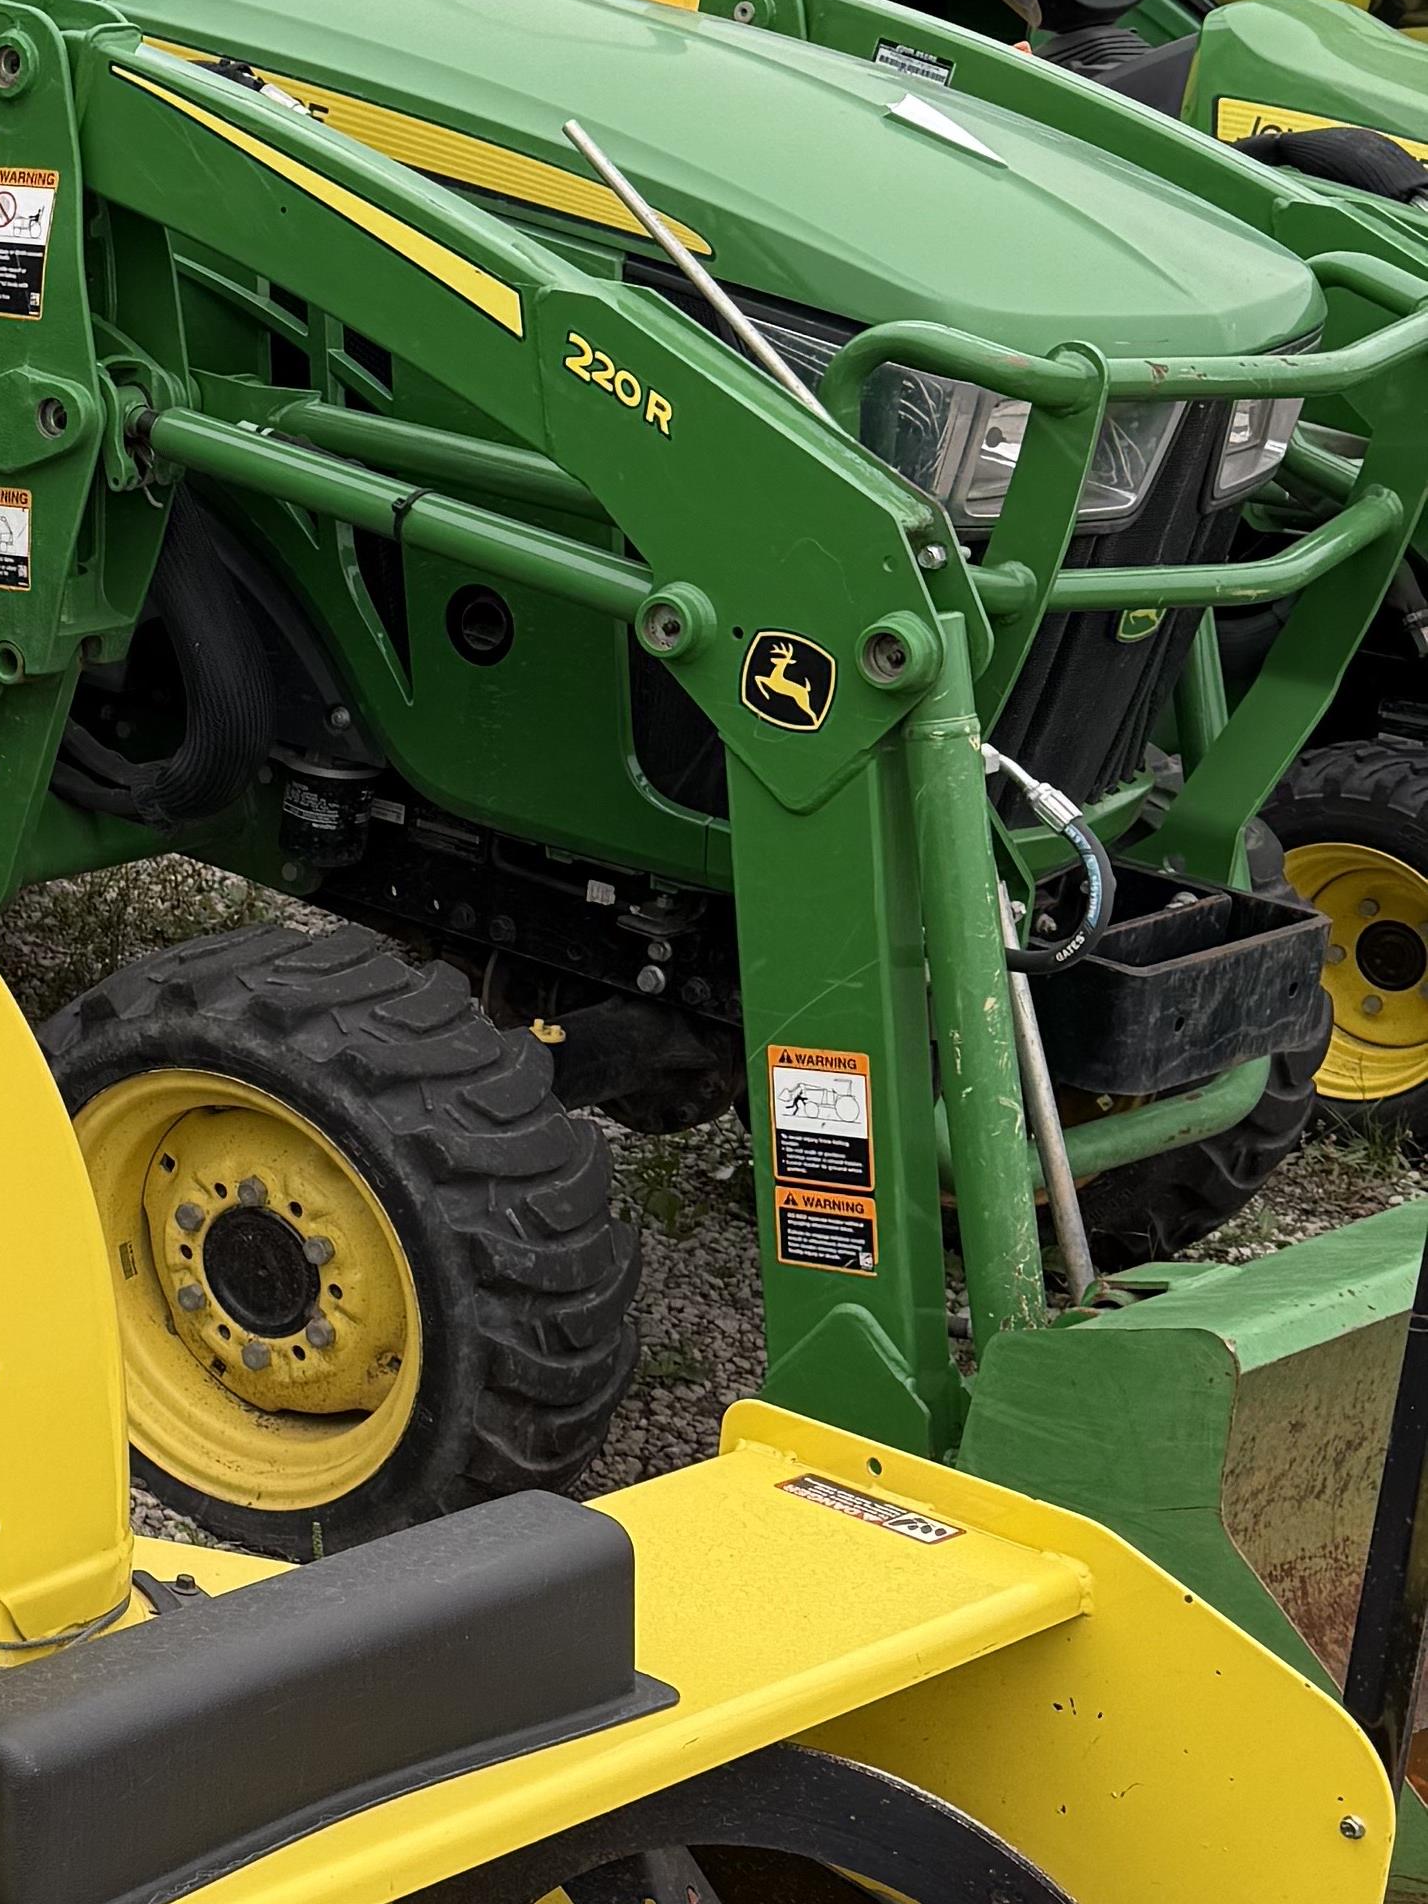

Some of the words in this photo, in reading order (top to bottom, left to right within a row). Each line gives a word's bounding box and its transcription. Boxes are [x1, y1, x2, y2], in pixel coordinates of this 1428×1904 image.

[0, 170, 55, 186] WARNING
[564, 330, 642, 408] 220
[644, 387, 672, 440] R
[1055, 933, 1085, 962] GATES
[795, 1052, 857, 1071] WARNING
[802, 1196, 865, 1215] WARNING
